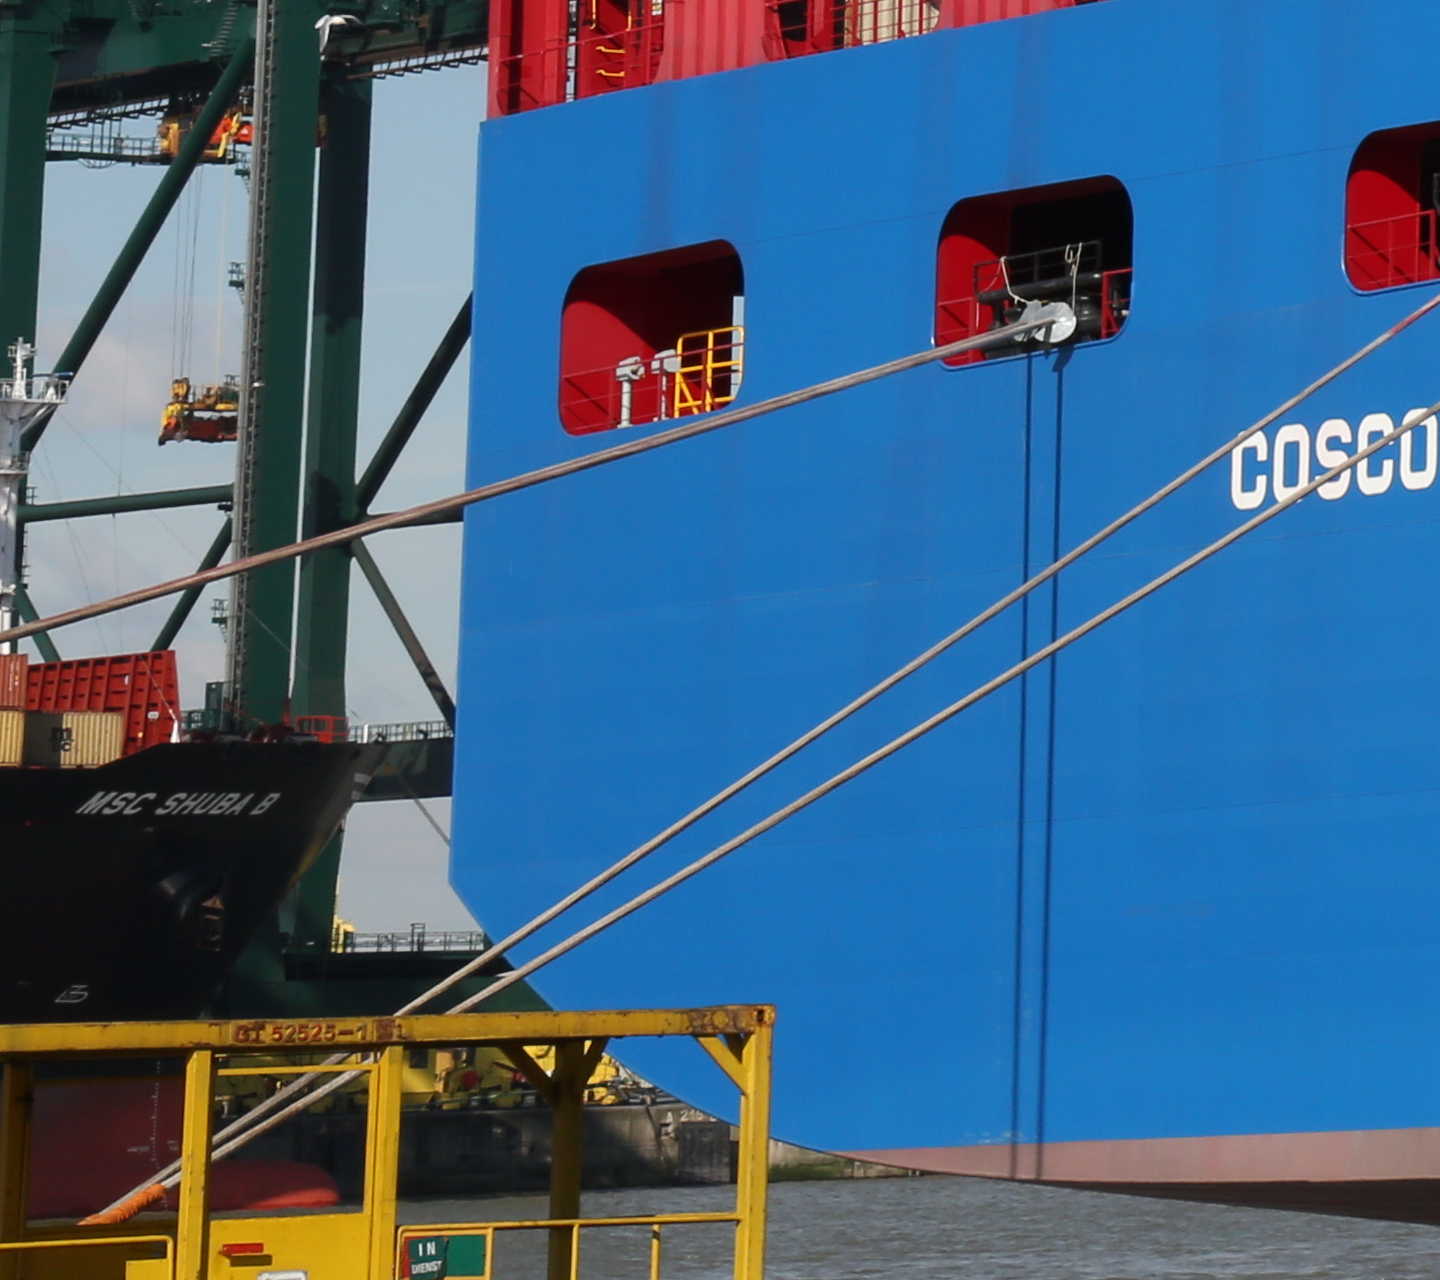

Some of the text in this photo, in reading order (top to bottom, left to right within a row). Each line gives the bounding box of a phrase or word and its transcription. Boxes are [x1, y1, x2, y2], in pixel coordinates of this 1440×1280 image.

[1229, 406, 1438, 511] COSCO
[76, 791, 282, 817] MSC SHUBA B
[418, 1241, 436, 1257] IN
